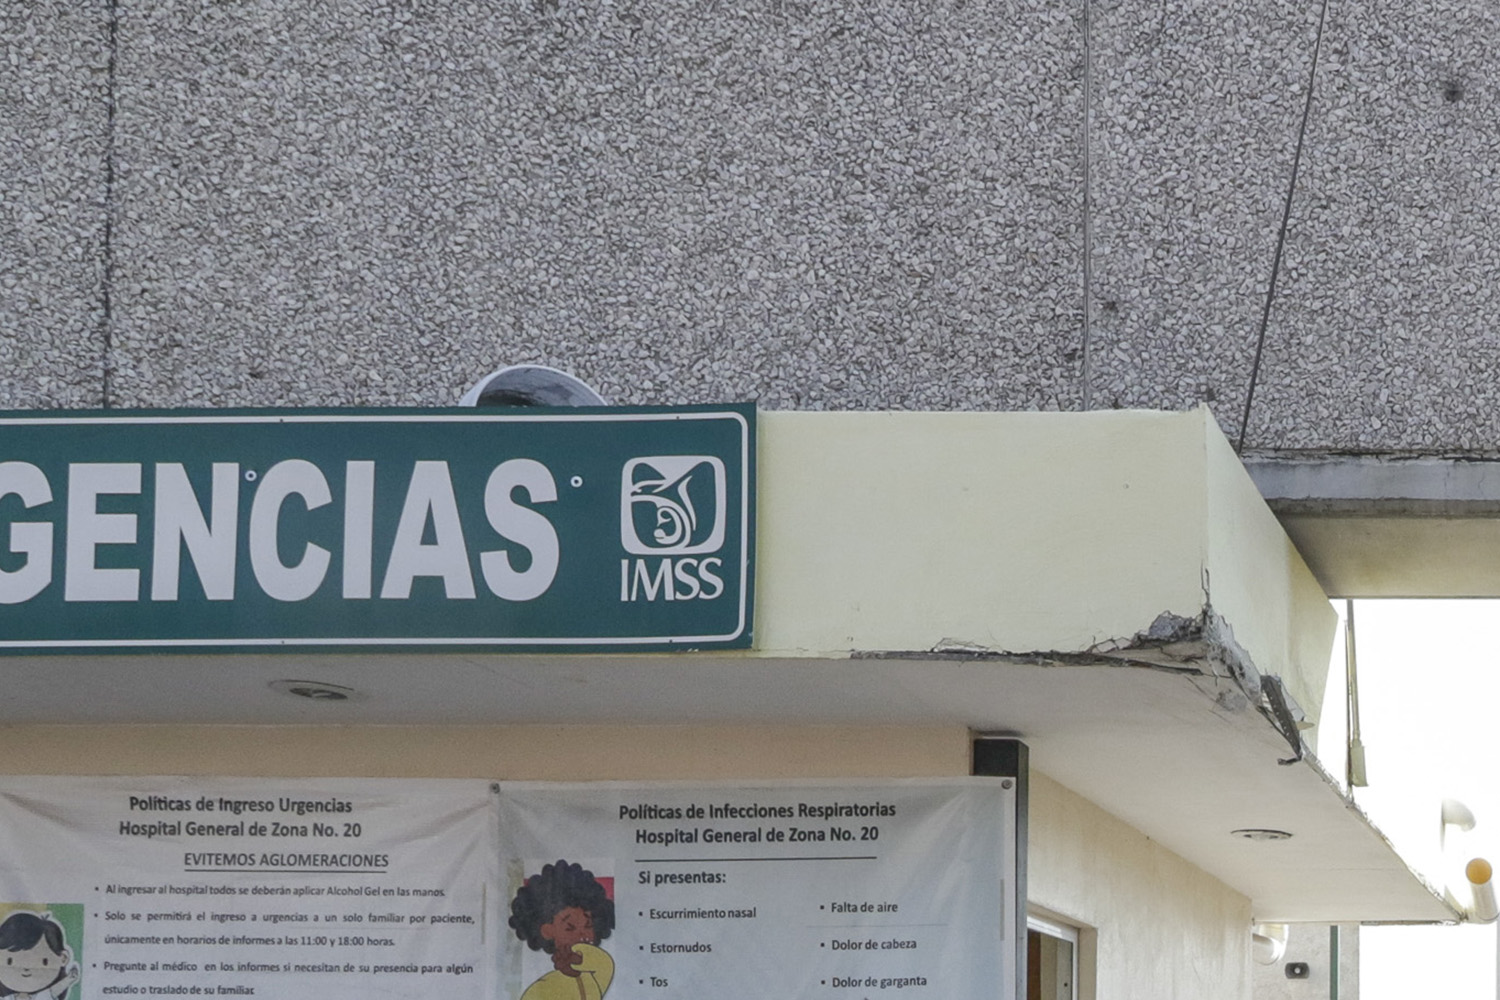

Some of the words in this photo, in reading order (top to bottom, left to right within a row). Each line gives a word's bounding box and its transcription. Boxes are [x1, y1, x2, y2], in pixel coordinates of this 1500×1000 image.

[0, 459, 559, 603] GENCIAS
[621, 557, 724, 602] IMSS
[128, 794, 192, 812] Políticas
[194, 795, 214, 812] de
[217, 796, 275, 816] Ingreso
[278, 796, 353, 816] Urgencias
[618, 802, 683, 820] Políticas
[685, 802, 705, 819] de
[708, 801, 794, 819] Infecciones
[797, 800, 896, 821] Respiratorias
[118, 819, 181, 839] Hospital
[184, 819, 244, 837] General
[247, 820, 268, 837] de
[270, 821, 308, 837] Zona
[311, 821, 339, 837] No.
[342, 821, 362, 838] 20
[635, 827, 698, 847] Hospital
[701, 826, 762, 843] General
[765, 826, 785, 843] de
[787, 826, 826, 842] Zona
[829, 826, 856, 842] No.
[859, 825, 879, 841] 20
[183, 851, 256, 866] EVITEMOS
[258, 852, 389, 868] AGLOMERACIONES
[637, 869, 651, 884] Si
[653, 870, 726, 887] presentas:
[104, 883, 116, 894] Al
[116, 883, 157, 896] ingresar
[168, 884, 209, 897] hospital
[208, 884, 237, 895] todos
[250, 884, 292, 896] deberán
[292, 885, 326, 898] aplicar
[325, 885, 363, 896] Alcohol
[363, 885, 381, 897] Gel
[396, 886, 411, 897] las
[648, 906, 727, 920] Escurrimiento
[726, 906, 757, 919] nasal
[830, 900, 858, 913] Falta
[859, 901, 875, 913] de
[876, 901, 898, 913] aire
[104, 910, 126, 921] Solo
[146, 910, 192, 923] permitirá
[210, 911, 247, 924] ingreso
[261, 911, 309, 924] urgencias
[342, 912, 364, 923] solo
[367, 911, 405, 923] familiar
[408, 914, 427, 925] por
[429, 912, 475, 925] paciente,
[103, 933, 162, 945] únicamente
[176, 934, 217, 945] horarios
[231, 934, 276, 946] informes
[284, 934, 299, 946] las
[300, 935, 328, 946] 11:00
[337, 935, 365, 946] 18:00
[649, 940, 712, 954] Estornudos
[831, 938, 863, 951] Dolor
[863, 938, 879, 950] de
[880, 937, 917, 950] cabeza
[102, 960, 147, 973] Pregunte
[160, 960, 198, 972] médico
[219, 961, 235, 972] los
[236, 961, 281, 972] informes
[293, 961, 341, 973] necesitan
[372, 962, 419, 975] presencia
[420, 964, 443, 975] para
[444, 962, 474, 976] algún
[649, 975, 669, 988] Tos
[831, 975, 863, 988] Dolor
[863, 975, 878, 987] de
[879, 975, 927, 989] garganta
[101, 984, 139, 995] estudio
[148, 984, 189, 995] traslado
